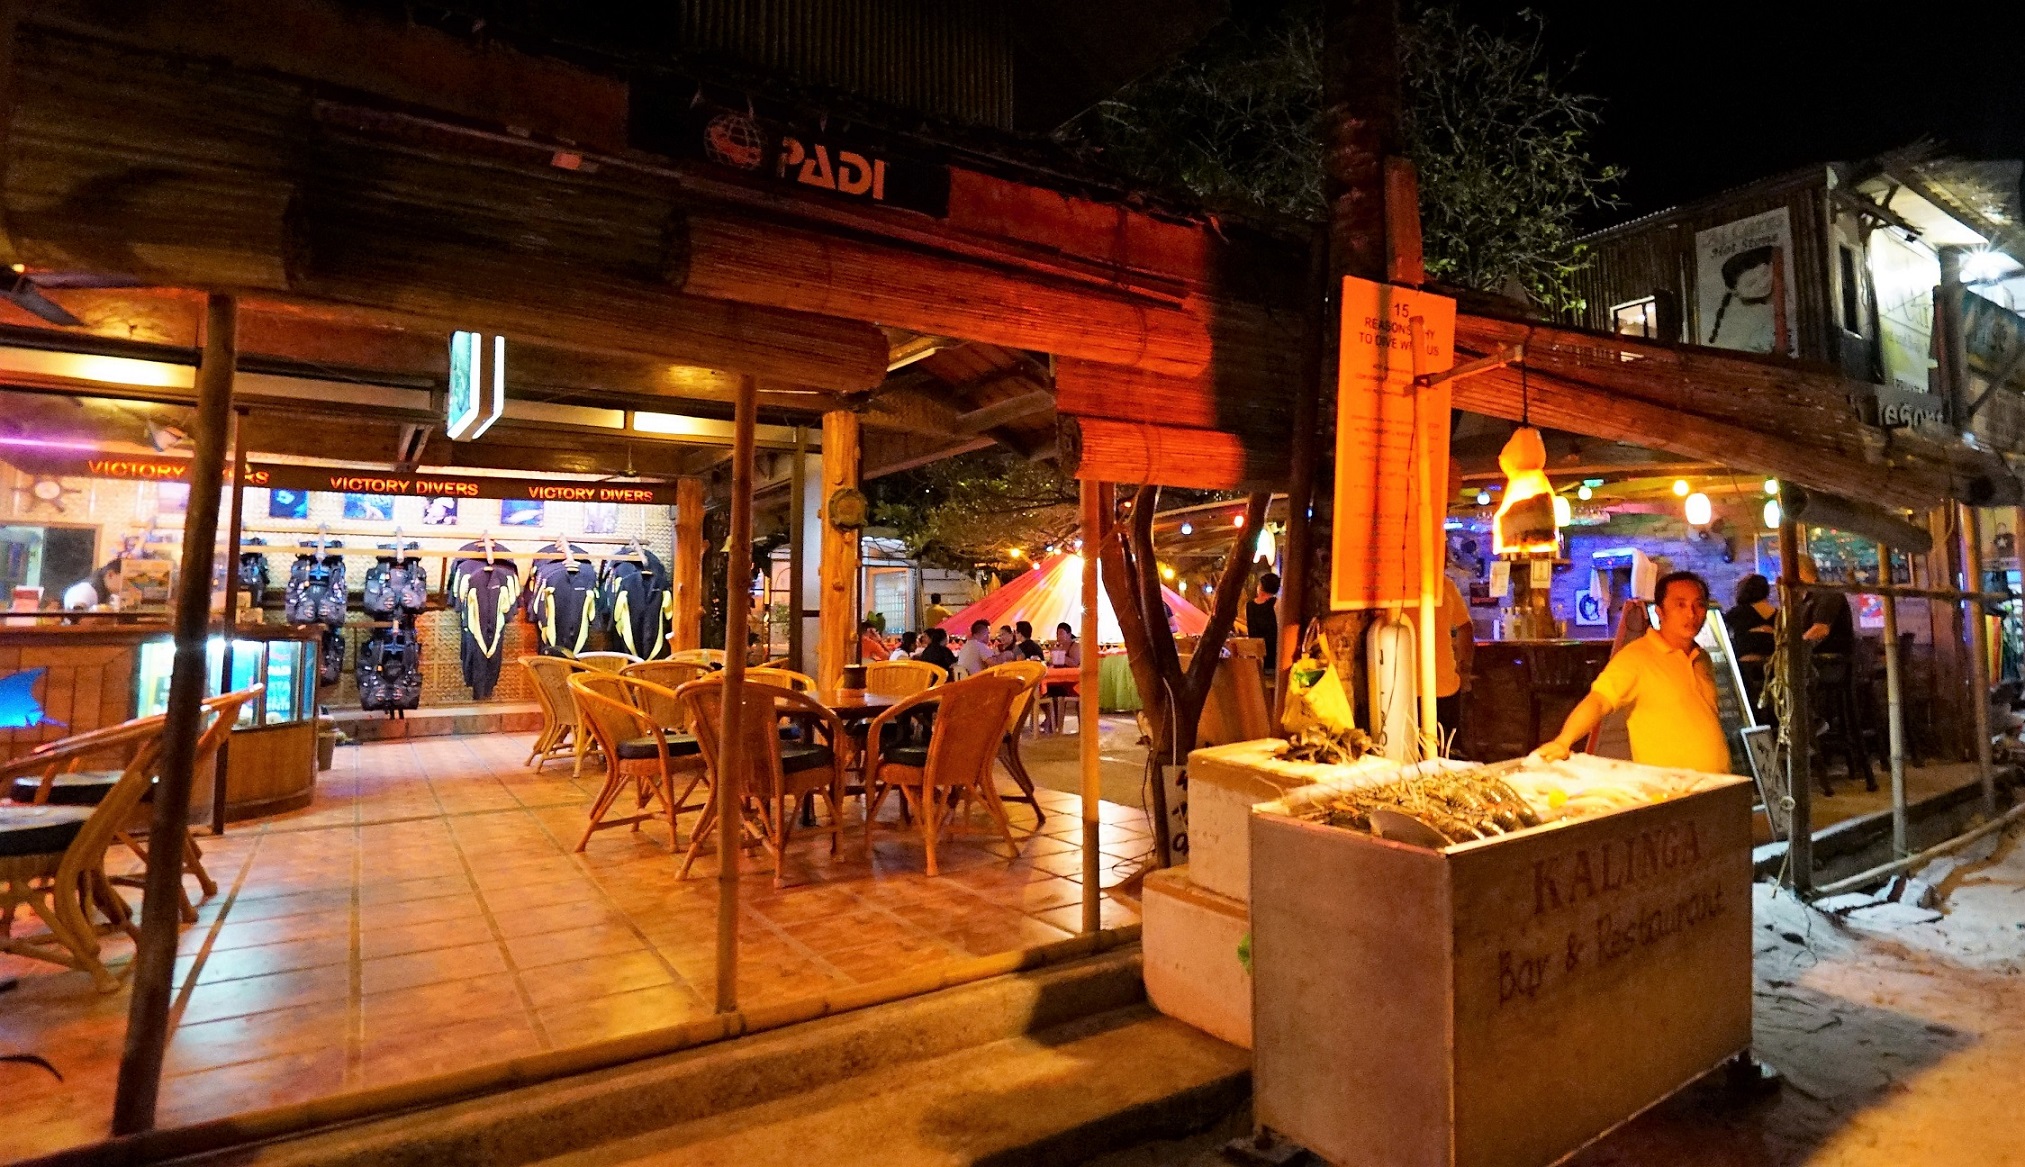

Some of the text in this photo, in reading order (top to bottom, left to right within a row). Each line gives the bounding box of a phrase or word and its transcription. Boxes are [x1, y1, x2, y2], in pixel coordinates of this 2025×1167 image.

[778, 136, 885, 200] PADI
[1393, 303, 1409, 318] 15
[1359, 331, 1373, 345] TO
[1426, 344, 1440, 357] US
[88, 459, 186, 480] VICTORY
[330, 476, 479, 497] VICTORY DIVERS
[528, 485, 654, 502] VICTORY DIVERS
[1533, 820, 1702, 916] KALINGA
[1498, 881, 1726, 1005] Bar & Restaurant
